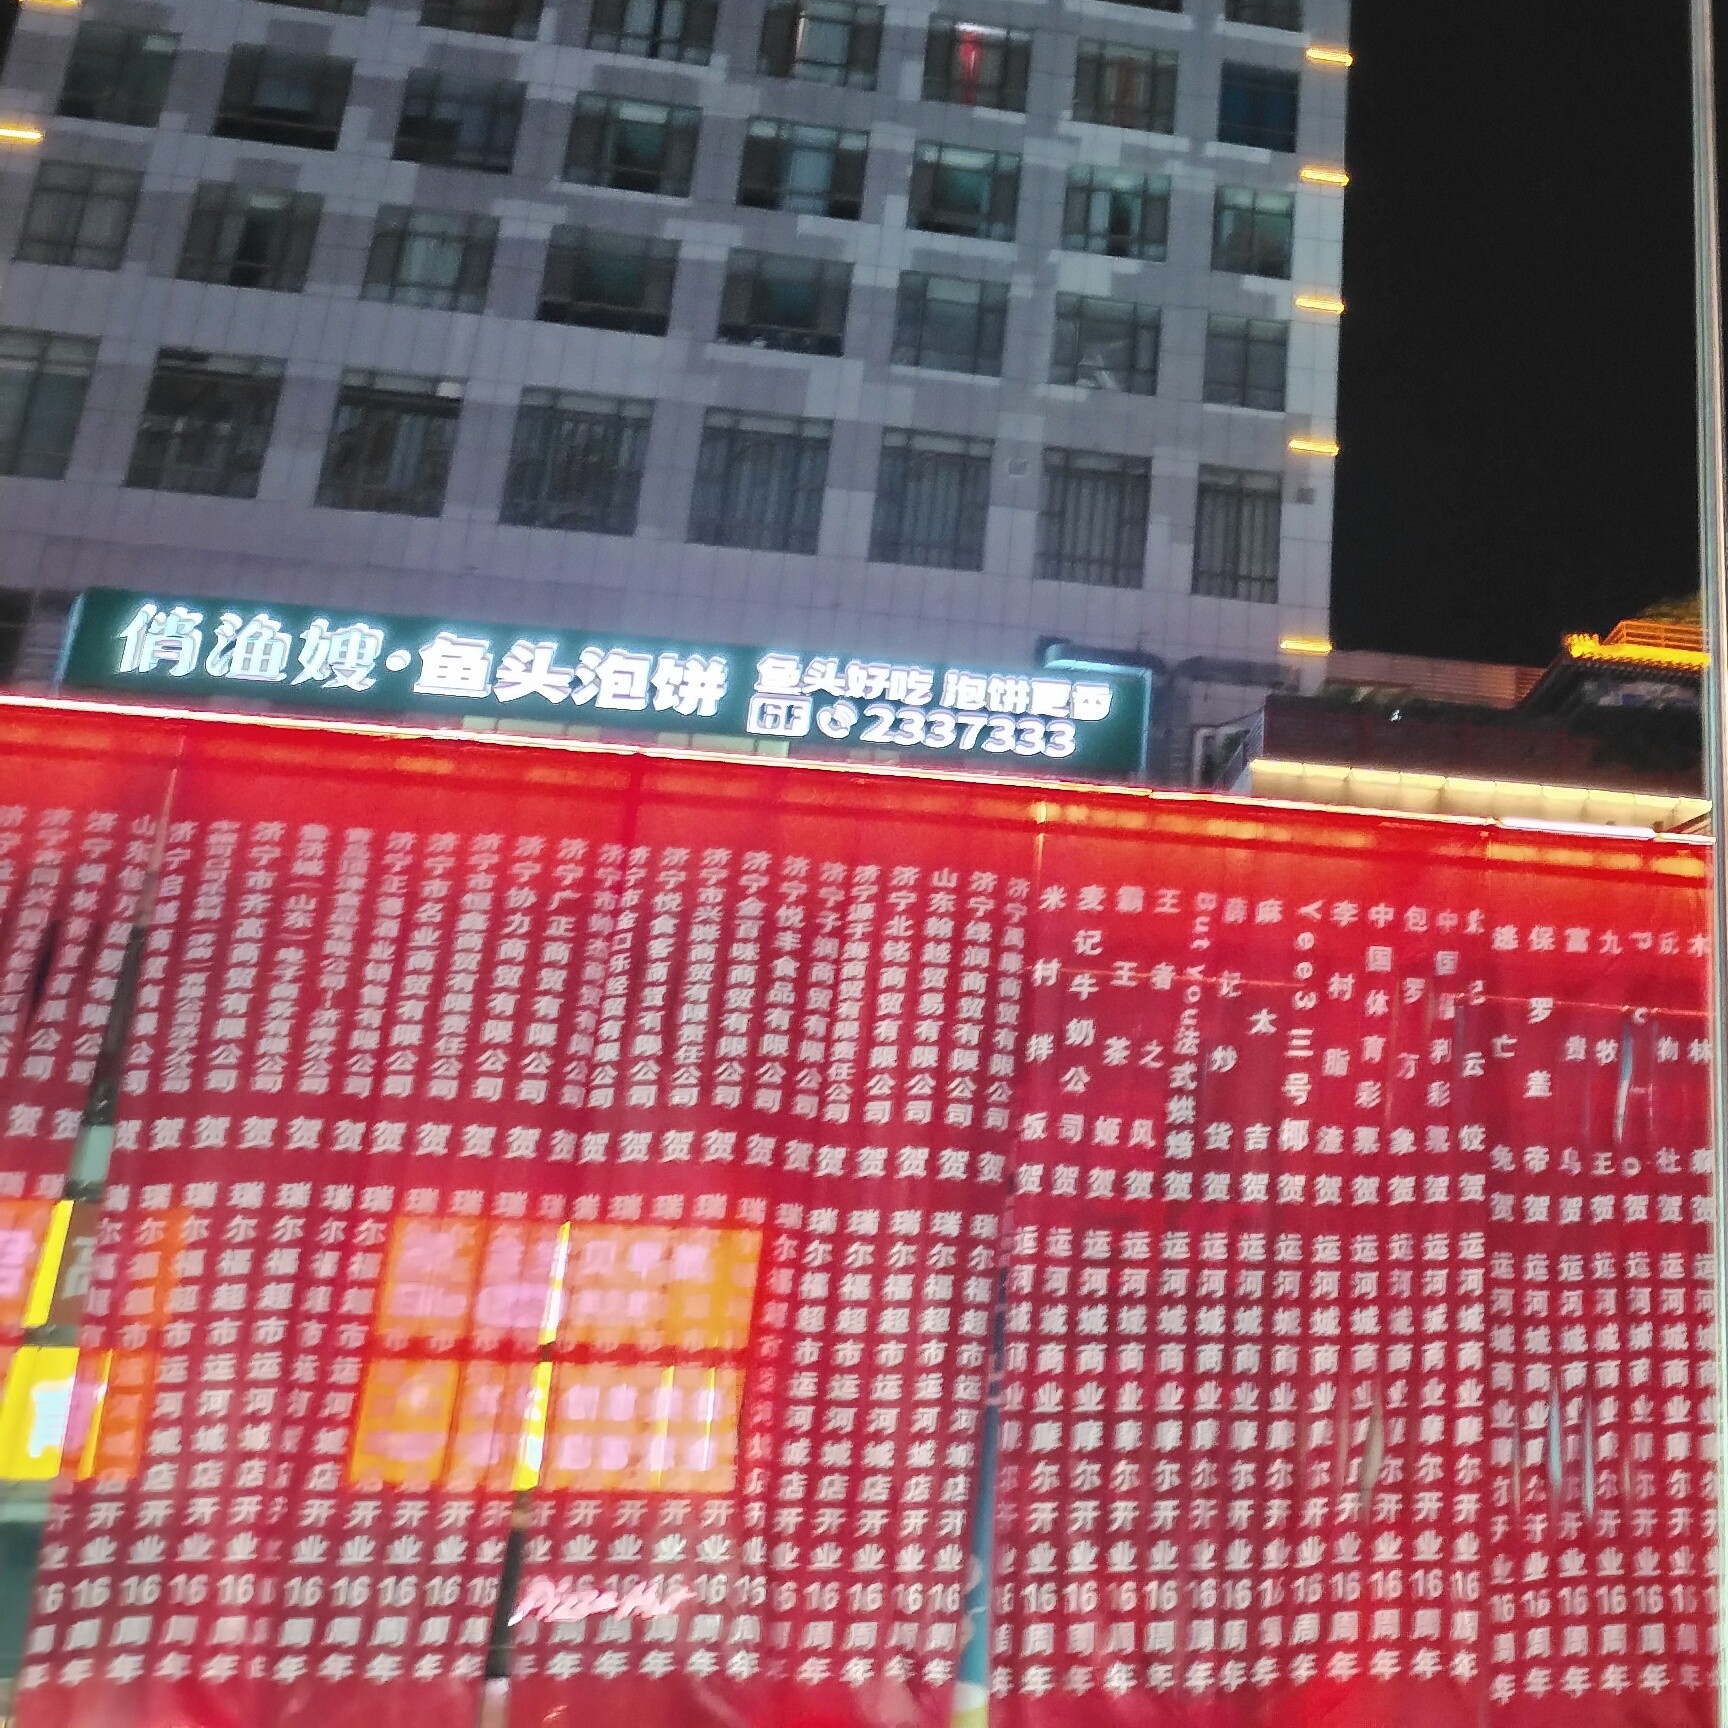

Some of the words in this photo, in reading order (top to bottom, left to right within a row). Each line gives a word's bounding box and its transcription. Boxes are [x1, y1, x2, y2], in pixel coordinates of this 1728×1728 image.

[754, 652, 935, 706] 鱼头好吃
[941, 669, 1113, 721] 泡饼更香
[860, 703, 1077, 758] 2337333
[1523, 925, 1555, 1172] 保罗盖帝
[1560, 927, 1591, 1176] 富贵鸟
[1590, 930, 1622, 1175] 九牧王
